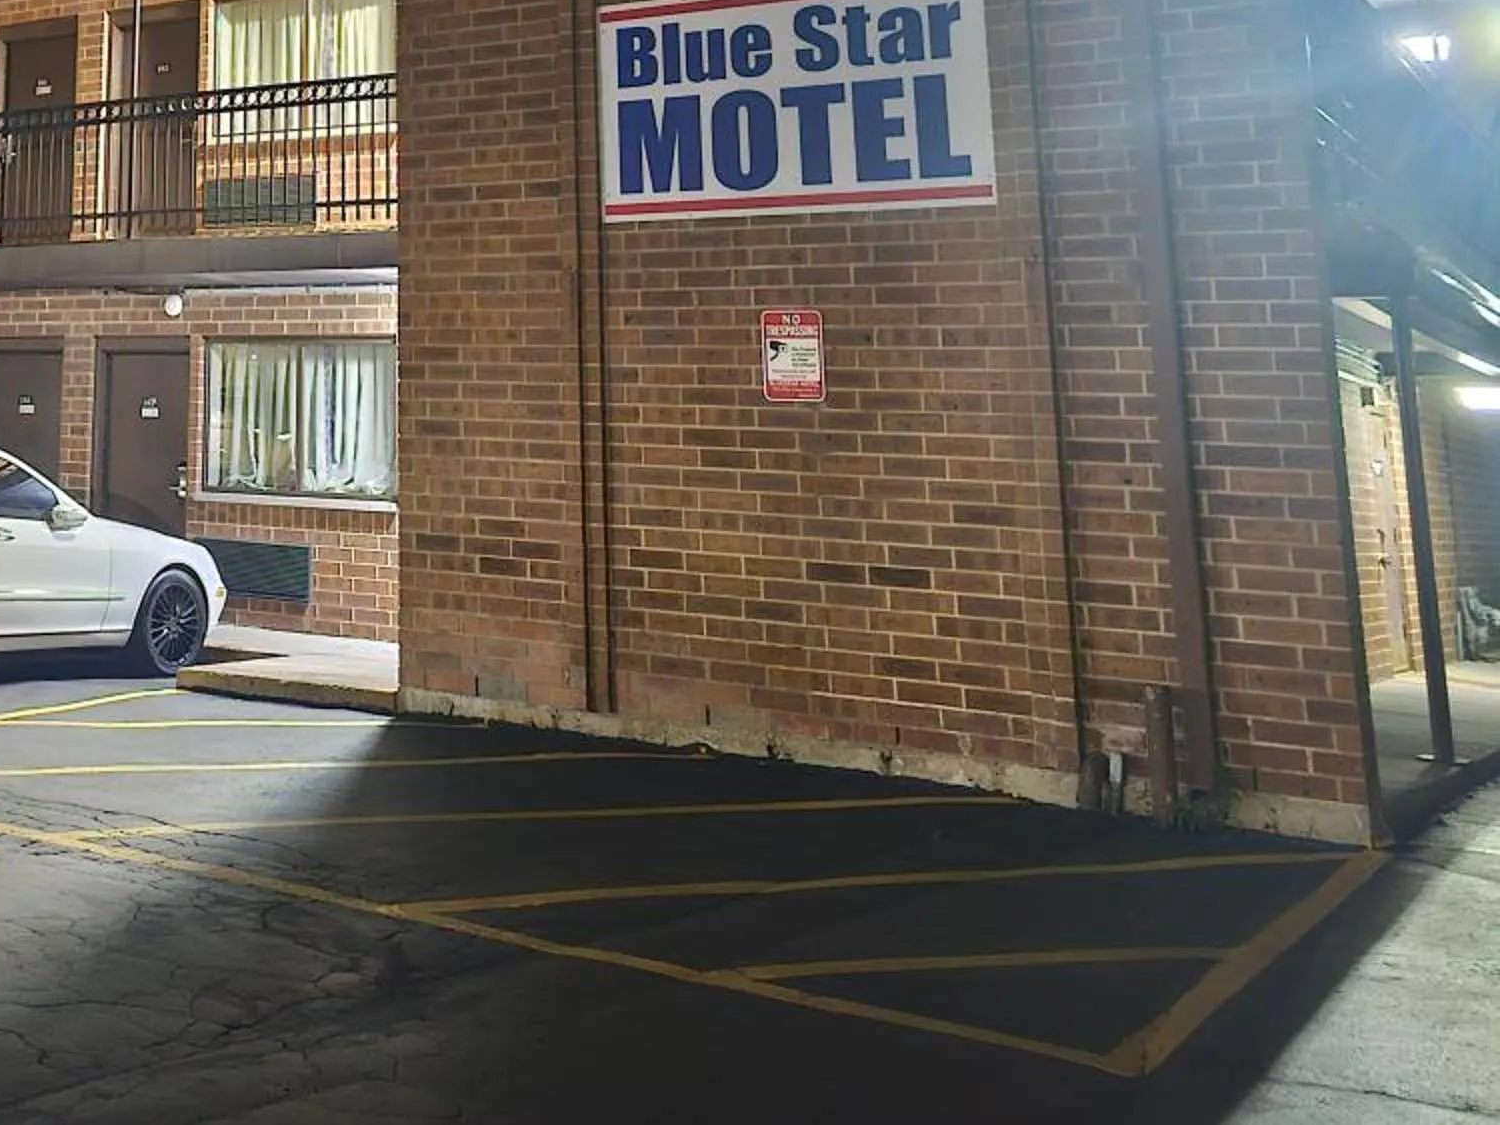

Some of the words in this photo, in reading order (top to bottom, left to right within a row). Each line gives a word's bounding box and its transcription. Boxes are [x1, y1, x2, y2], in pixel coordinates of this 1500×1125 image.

[616, 23, 772, 89] Blue
[793, 2, 961, 72] Star
[618, 74, 973, 195] MOTEL
[782, 314, 801, 324] NO
